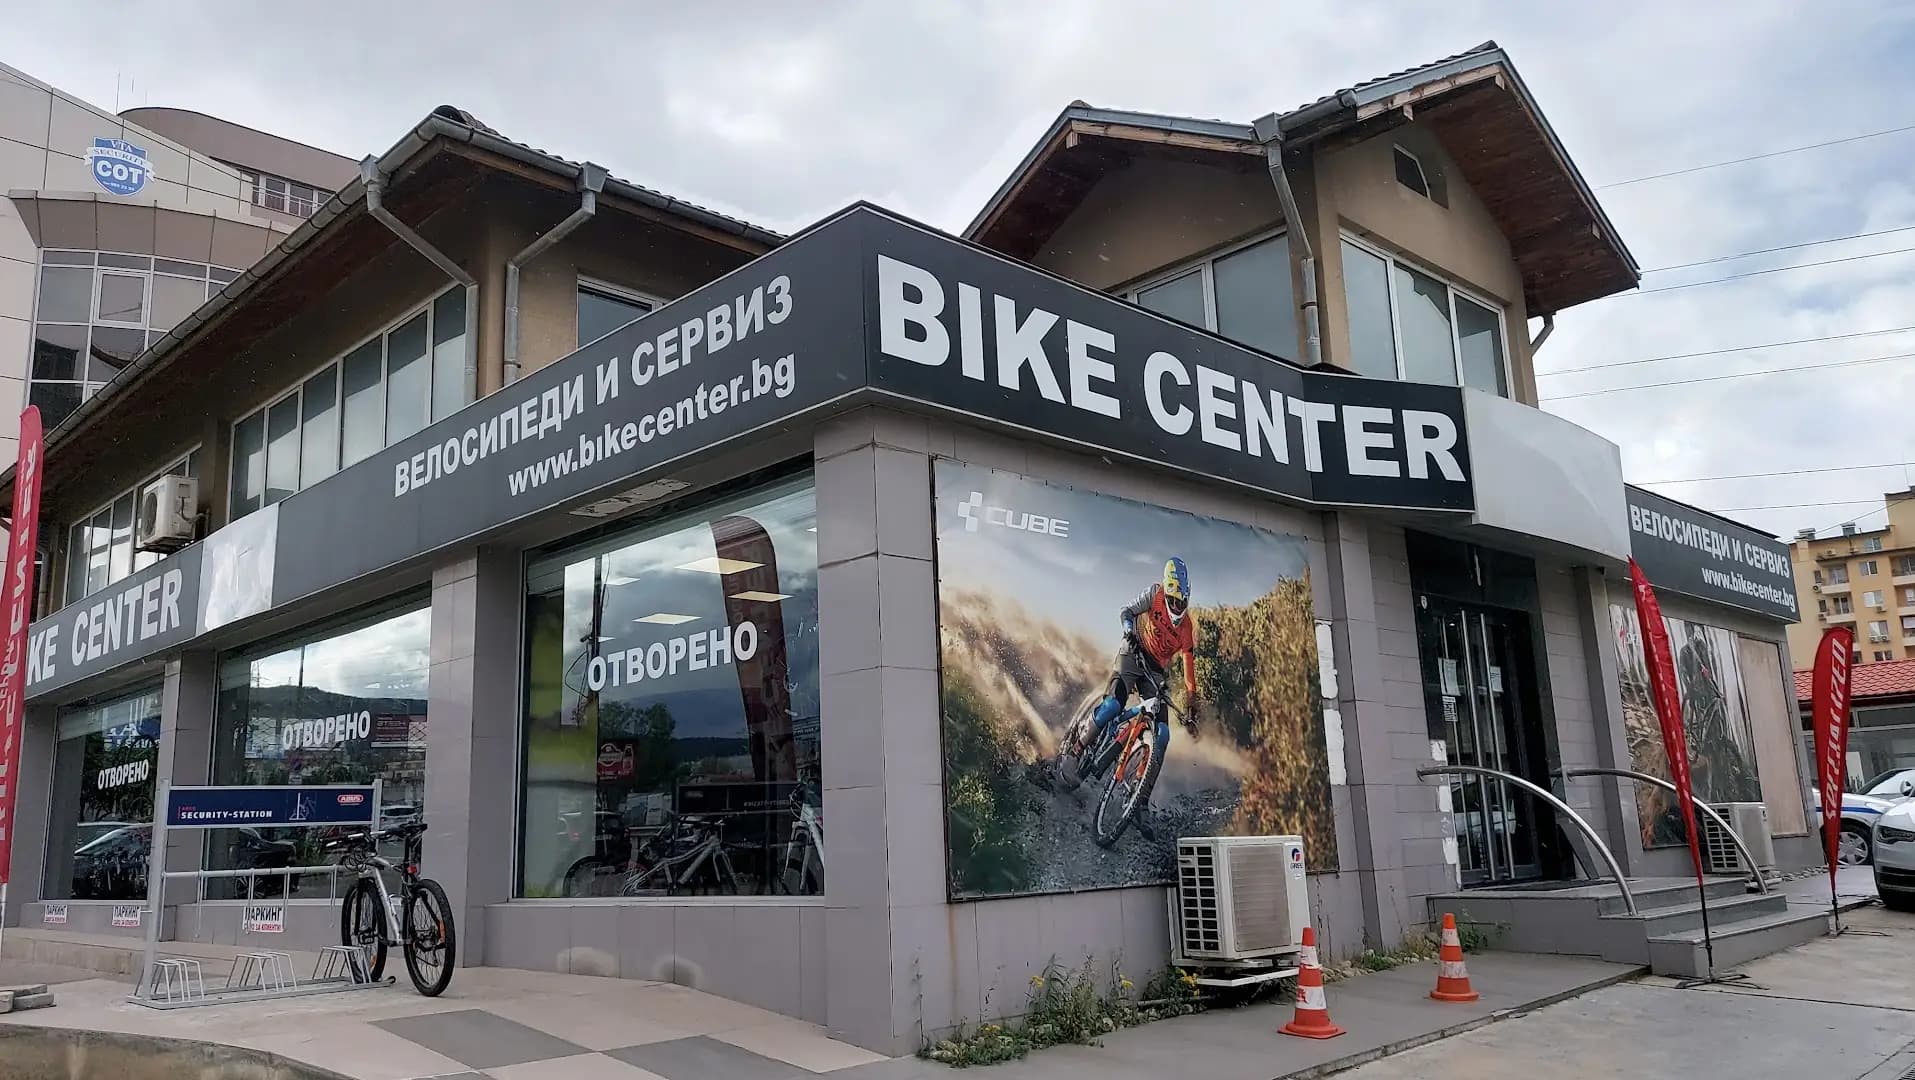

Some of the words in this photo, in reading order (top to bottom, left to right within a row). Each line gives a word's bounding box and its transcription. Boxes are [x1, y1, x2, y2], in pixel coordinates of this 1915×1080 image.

[394, 374, 584, 498] ВЕЛОСИПЕДИ
[596, 357, 619, 405] И
[631, 275, 793, 387] СЕРВИЗ
[877, 253, 1122, 420] BIKE
[1142, 350, 1467, 482] CENTER
[508, 353, 796, 497] www.bikecenter.bg
[985, 505, 1070, 538] CUBE
[1629, 504, 1731, 561] ВЕЛОСИПЕДИ
[1732, 538, 1743, 563] И
[1744, 543, 1790, 578] СЕРВИЗ
[1701, 567, 1796, 613] www.bikecenter.bg
[27, 624, 59, 686] KE
[71, 568, 183, 667] CENTER
[587, 620, 758, 691] ОТВОРЕНО
[282, 710, 371, 750] ОТВОРЕНО
[97, 758, 149, 790] ОТВОРЕНО
[181, 810, 273, 820] SECURITY-STATION
[245, 907, 282, 921] ПАРКИНГ
